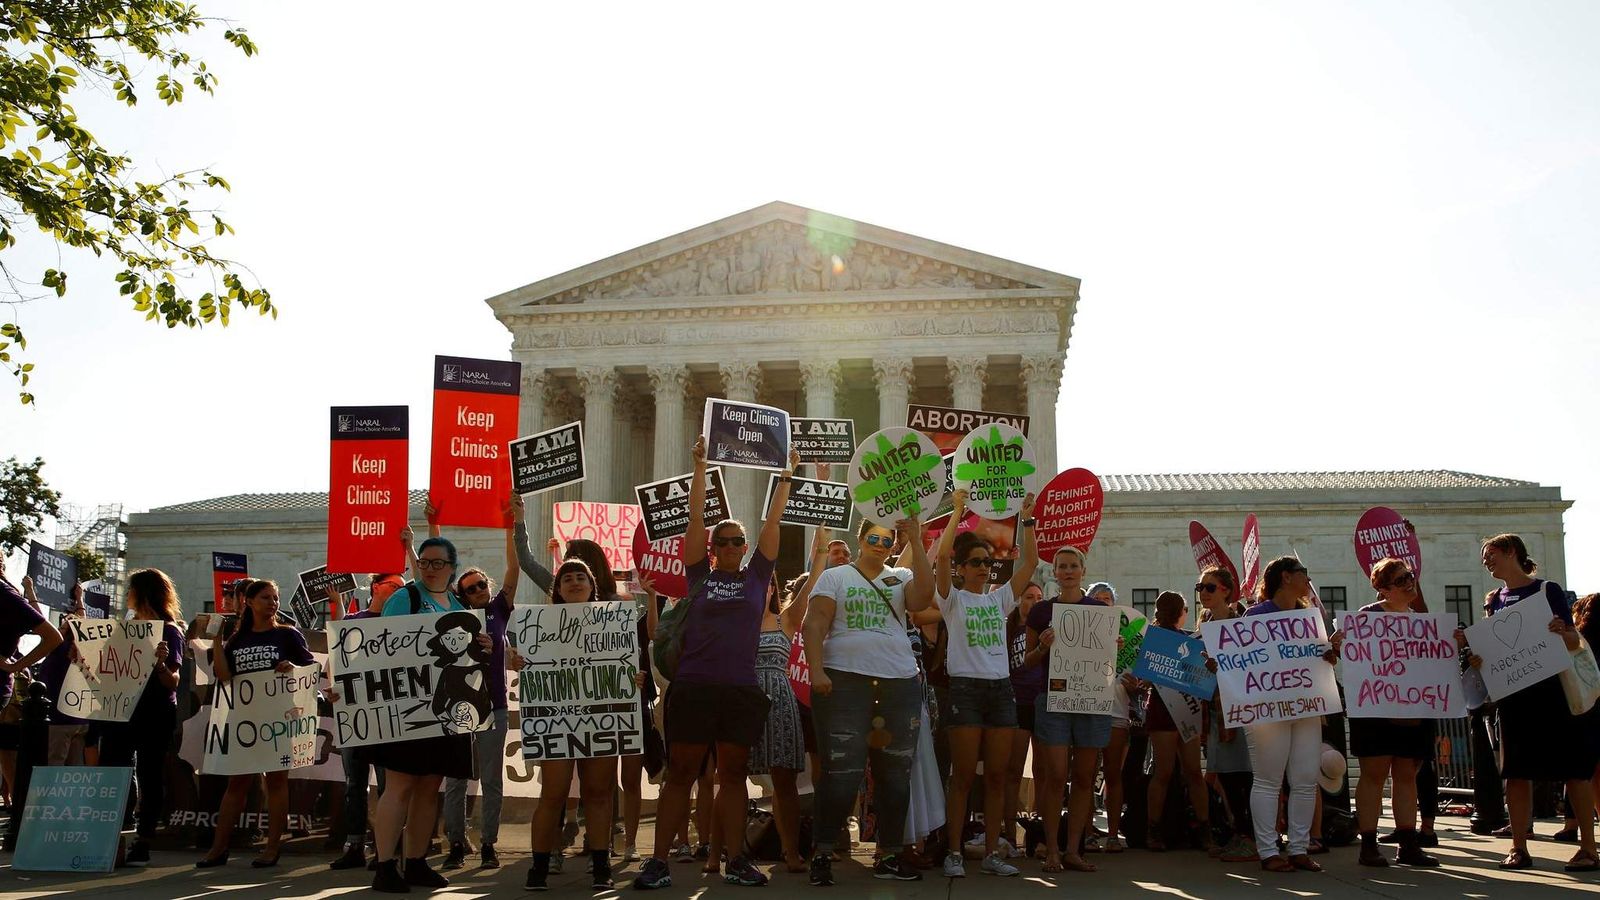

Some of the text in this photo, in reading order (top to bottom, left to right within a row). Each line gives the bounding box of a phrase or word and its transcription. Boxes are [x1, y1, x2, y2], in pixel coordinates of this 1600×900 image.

[677, 327, 727, 341] EQUAL
[462, 370, 490, 380] NARAL
[356, 419, 381, 427] NARAL
[457, 405, 494, 428] Keep
[722, 406, 780, 427] Keep Clinics
[738, 426, 763, 444] Open
[792, 421, 848, 435] I AM
[450, 436, 498, 460] Clinics
[516, 429, 575, 460] I AM
[794, 440, 849, 448] PRO-LIFE
[966, 444, 1024, 464] UNITED
[518, 453, 577, 476] PRO-LIFE
[734, 450, 759, 459] NARAL
[858, 441, 921, 481] UNITED
[352, 454, 386, 478] Keep
[519, 464, 578, 486] GENERATION
[987, 465, 1007, 475] FOR
[455, 468, 492, 492] Open
[886, 469, 910, 486] FOR
[970, 476, 1023, 489] ABORTION
[347, 485, 390, 505] Clinics
[645, 488, 660, 505] I
[796, 482, 847, 500] AM
[874, 471, 931, 506] ABORTION
[970, 488, 1025, 501] COVERAGE
[1047, 484, 1095, 502] FEMINIST
[876, 482, 938, 518] COVERAGE
[1043, 497, 1096, 517] MAJORITY
[351, 516, 385, 539] Open
[1035, 511, 1099, 531] LEADERSHIP
[1037, 525, 1095, 543] ALLIANCES
[1357, 523, 1410, 545] FEMINISTS
[650, 540, 680, 555] ARE
[1370, 539, 1410, 560] ARE THE
[37, 550, 68, 570] #STOP
[640, 554, 687, 577] MAJO
[42, 564, 62, 580] THE
[36, 575, 65, 594] SHAM
[845, 600, 890, 616] UNITED
[965, 605, 999, 619] BRAVE
[71, 621, 154, 642] KEEP YOUR
[518, 607, 582, 655] Health
[582, 606, 592, 626] &
[965, 617, 1003, 632] UNITED
[1218, 616, 1319, 650] ABORTION
[1343, 613, 1439, 641] ABORTION
[233, 645, 278, 656] PROTECT
[332, 625, 433, 668] Protect
[584, 631, 635, 654] REGULATIONS
[1345, 639, 1455, 662] ON DEMAND
[236, 659, 272, 673] ACCESS
[560, 657, 587, 667] FOR
[1053, 648, 1115, 677] SCOTUS
[1144, 650, 1181, 669] PROTECT
[1216, 642, 1326, 673] RIGHTS REQUIRE
[1490, 640, 1547, 675] ABORTION
[1148, 661, 1185, 680] PROTECT
[1506, 660, 1543, 686] ACCESS
[214, 672, 318, 710] NO uterus
[334, 664, 434, 706] THEM
[520, 664, 637, 703] ABORTION CLINICS
[1245, 668, 1313, 694] ACCESS
[64, 689, 100, 712] OFF
[103, 691, 123, 719] MY
[1048, 695, 1112, 711] FORMATION
[1358, 678, 1450, 713] APOLOGY
[560, 705, 581, 716] ARE
[336, 704, 402, 745] BOTH
[522, 714, 635, 736] COMMON
[208, 720, 257, 755] NO
[293, 741, 313, 754] STOP
[522, 730, 642, 760] SENSE
[293, 756, 315, 768] SHAM
[55, 772, 104, 784] I DON'T
[36, 786, 118, 798] WANT TO BE
[24, 805, 119, 822] TRAPPED
[44, 831, 90, 843] IN 1973
